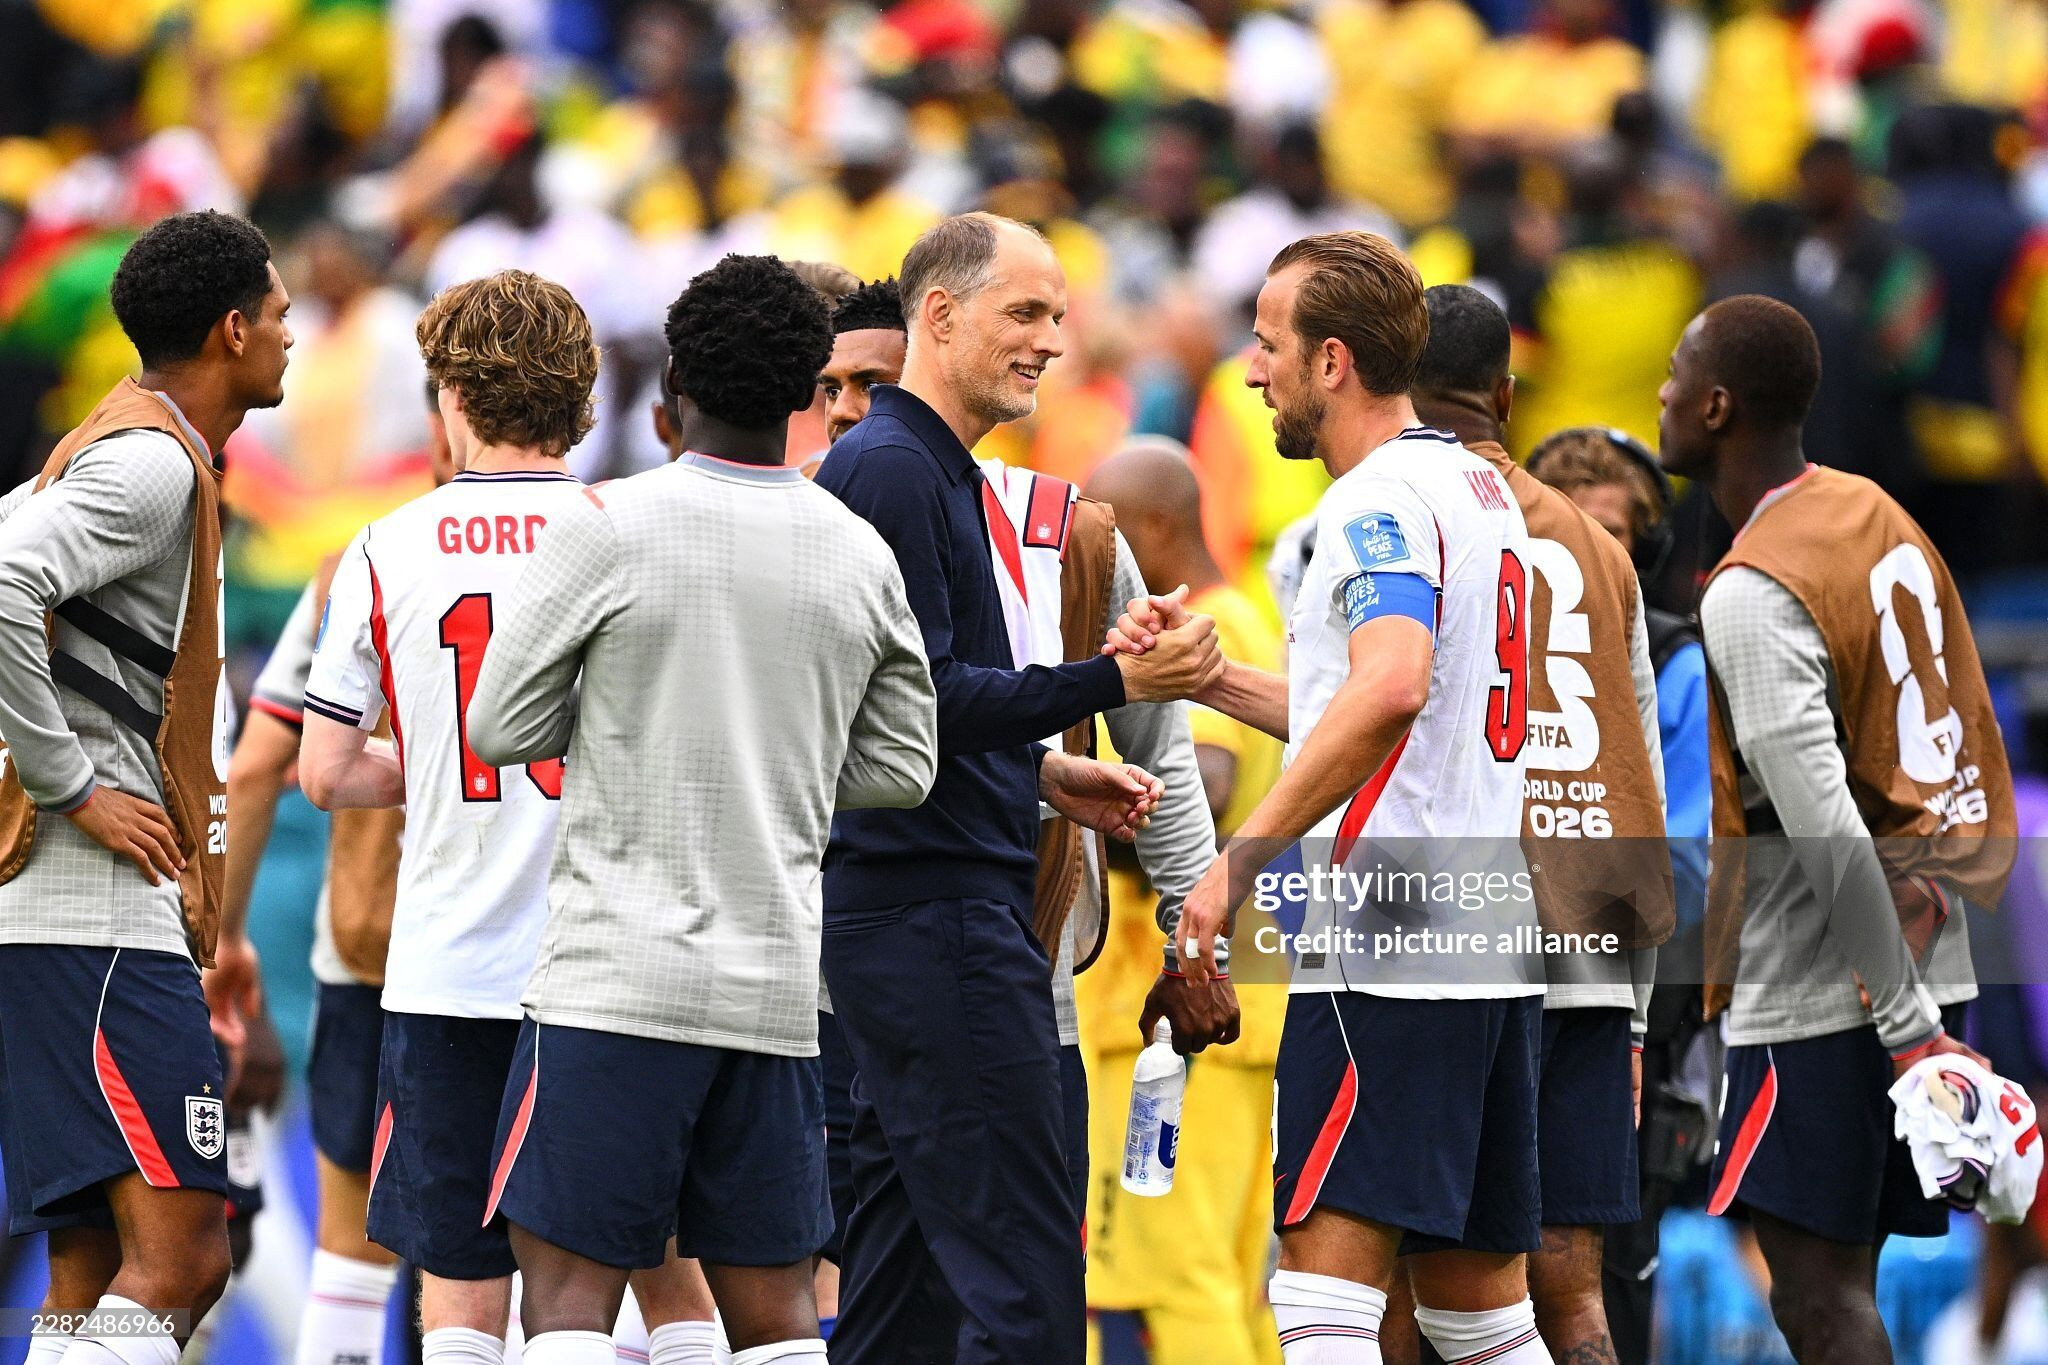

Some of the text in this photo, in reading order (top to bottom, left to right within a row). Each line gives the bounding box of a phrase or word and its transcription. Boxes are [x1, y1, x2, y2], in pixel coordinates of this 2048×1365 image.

[437, 515, 548, 554] GORD
[1484, 548, 1527, 763] 9
[1527, 723, 1573, 749] FIFA
[1523, 777, 1607, 803] ORLD CUP
[1529, 804, 1614, 840] 026
